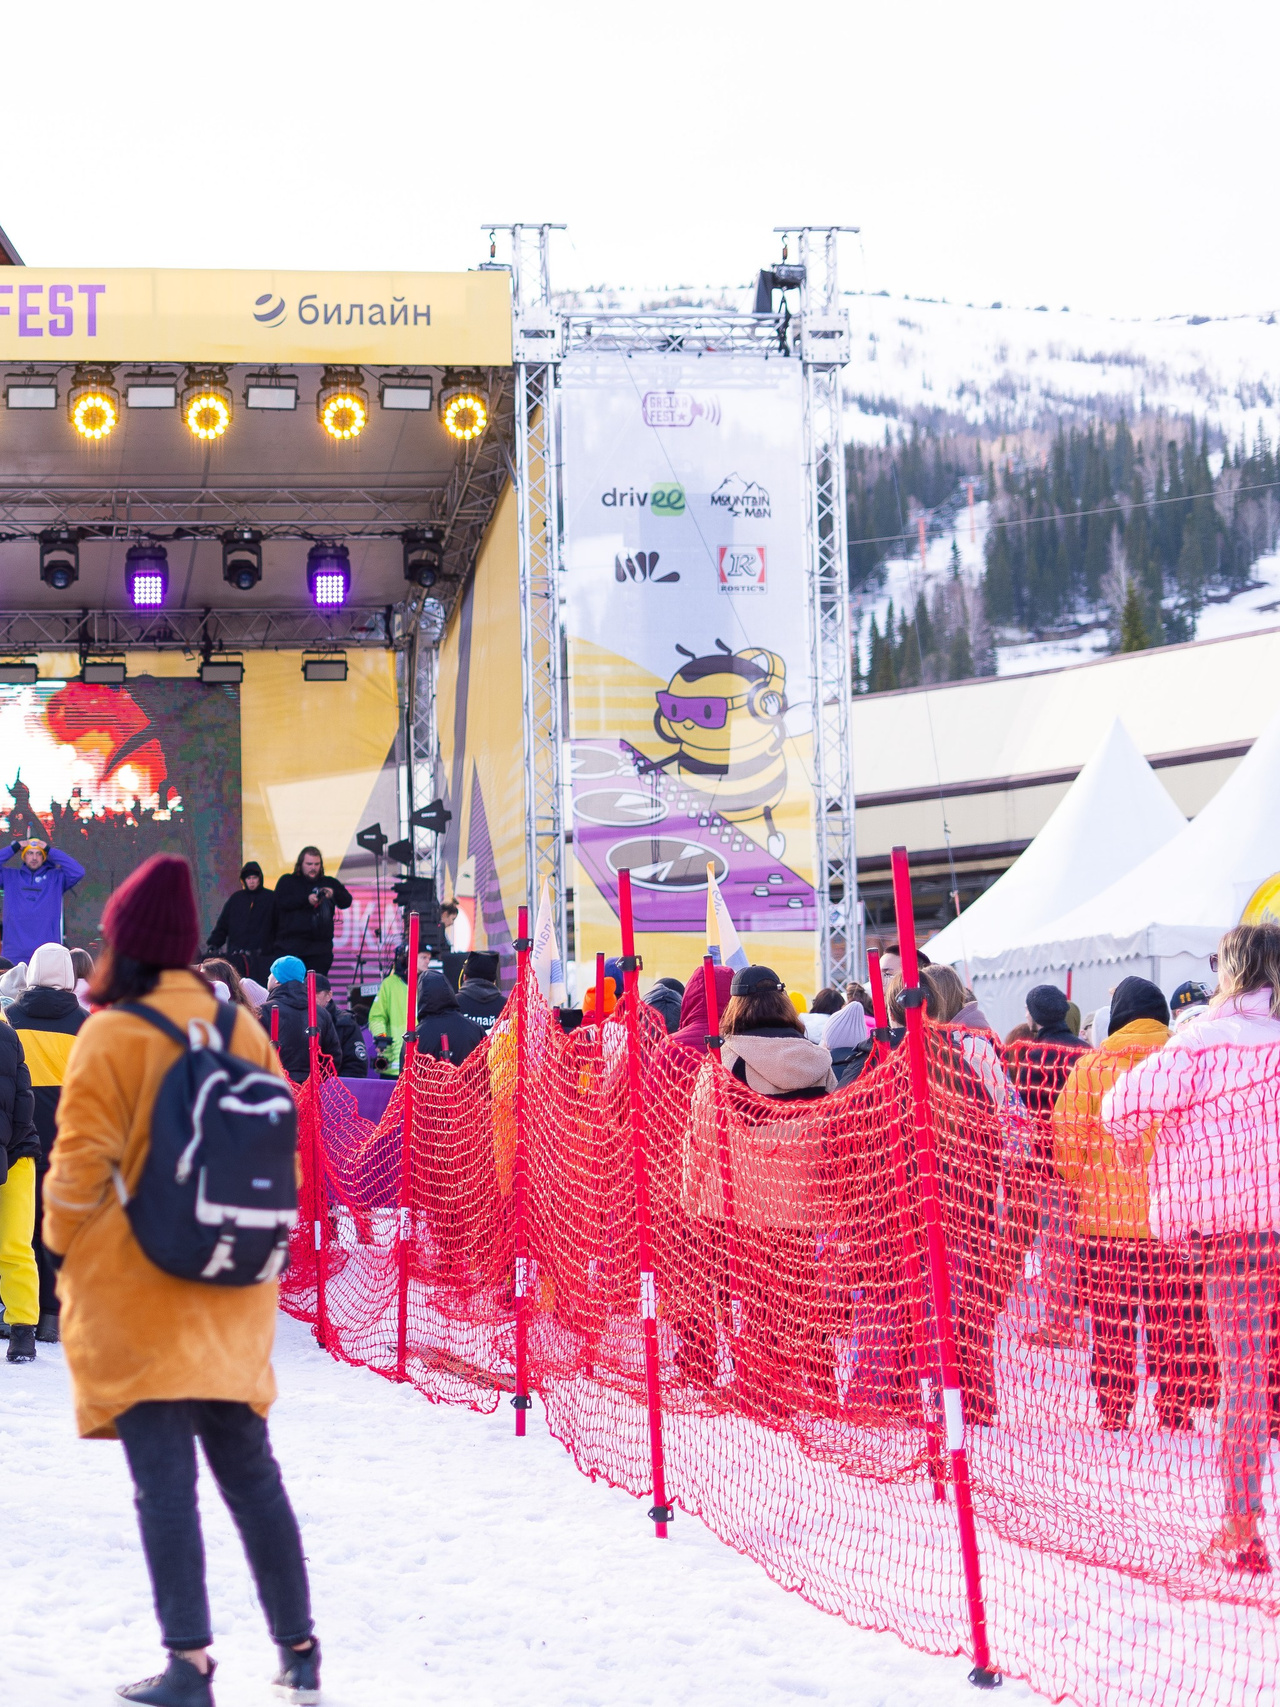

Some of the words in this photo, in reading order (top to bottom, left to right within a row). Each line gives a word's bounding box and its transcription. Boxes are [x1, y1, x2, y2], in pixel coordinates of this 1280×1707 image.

[298, 293, 431, 326] билайн
[650, 396, 688, 409] GRELKA
[650, 411, 675, 422] FEST
[601, 486, 686, 511] drivee
[710, 495, 770, 507] MOUNTAIN
[745, 507, 771, 519] MAN
